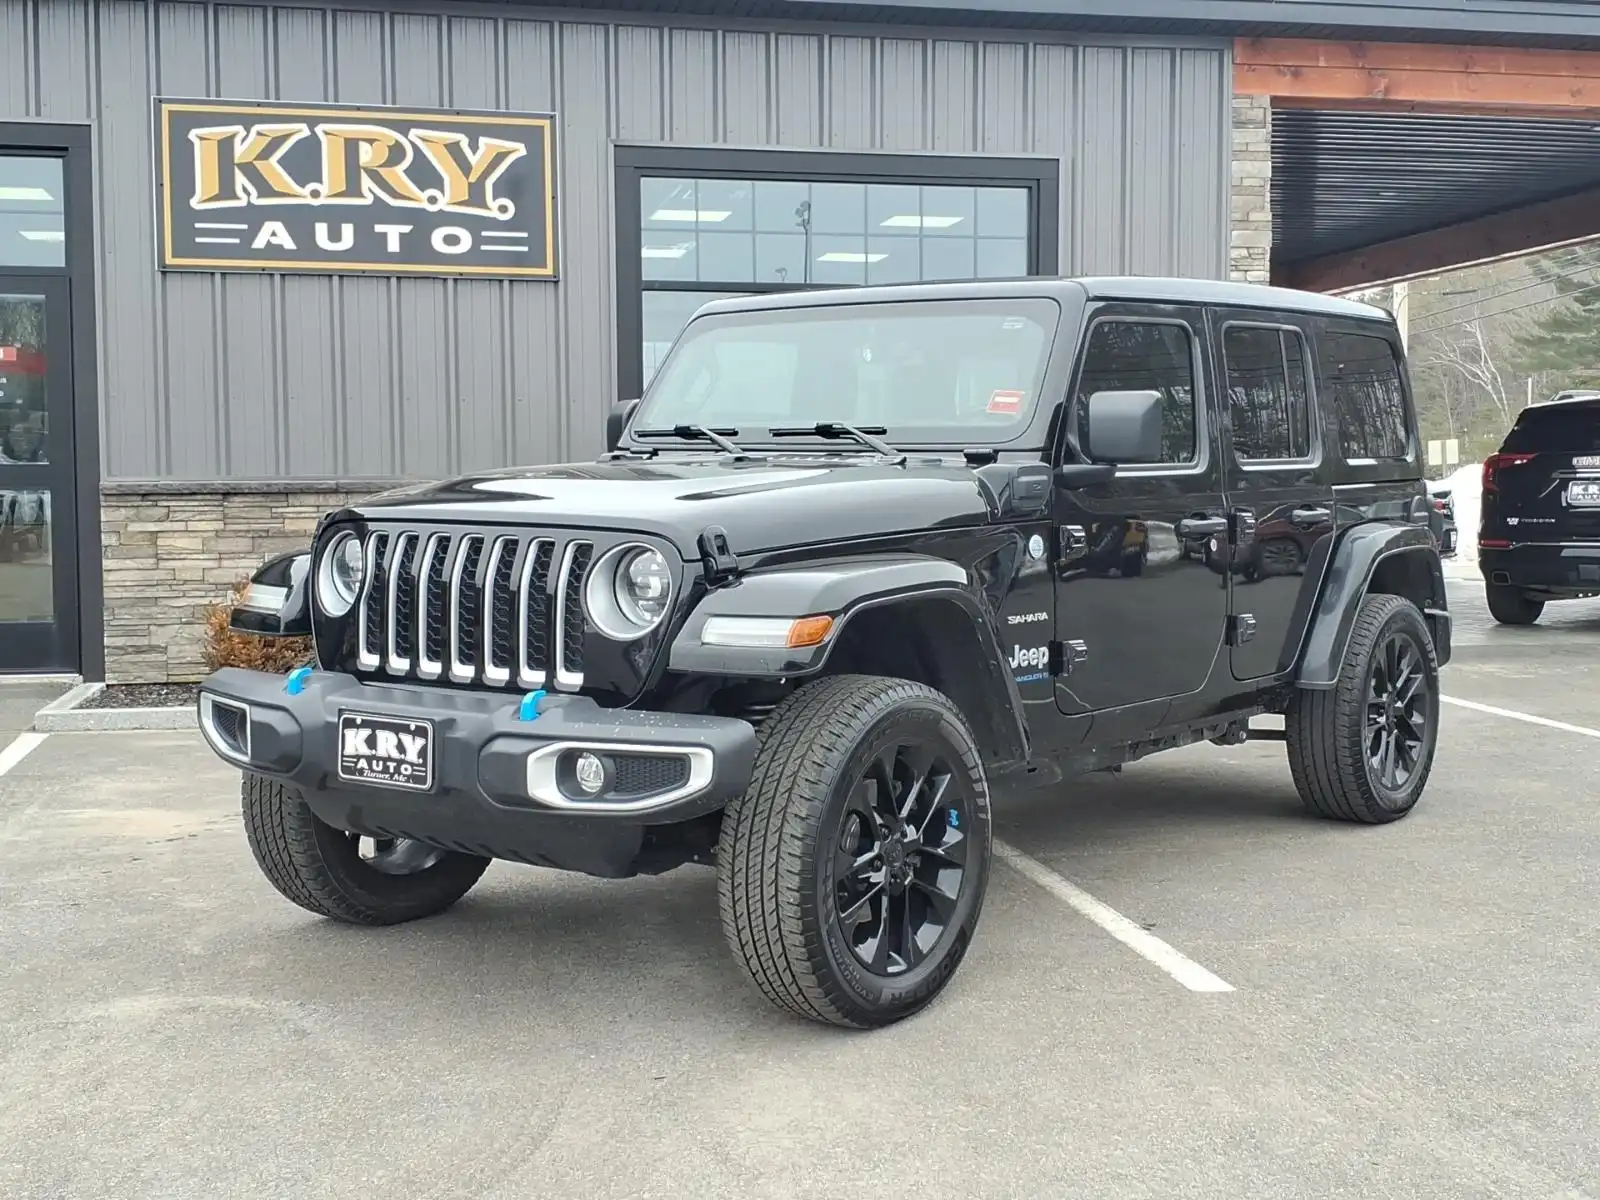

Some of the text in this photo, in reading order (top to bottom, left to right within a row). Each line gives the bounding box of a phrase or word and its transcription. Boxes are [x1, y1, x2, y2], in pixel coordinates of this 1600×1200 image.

[187, 122, 528, 221] K.R.Y.
[250, 220, 473, 255] AUTO
[1007, 611, 1049, 625] SAHARA
[1008, 643, 1050, 669] Jeep
[343, 728, 426, 765] K.R.Y.
[356, 757, 413, 775] AUTO
